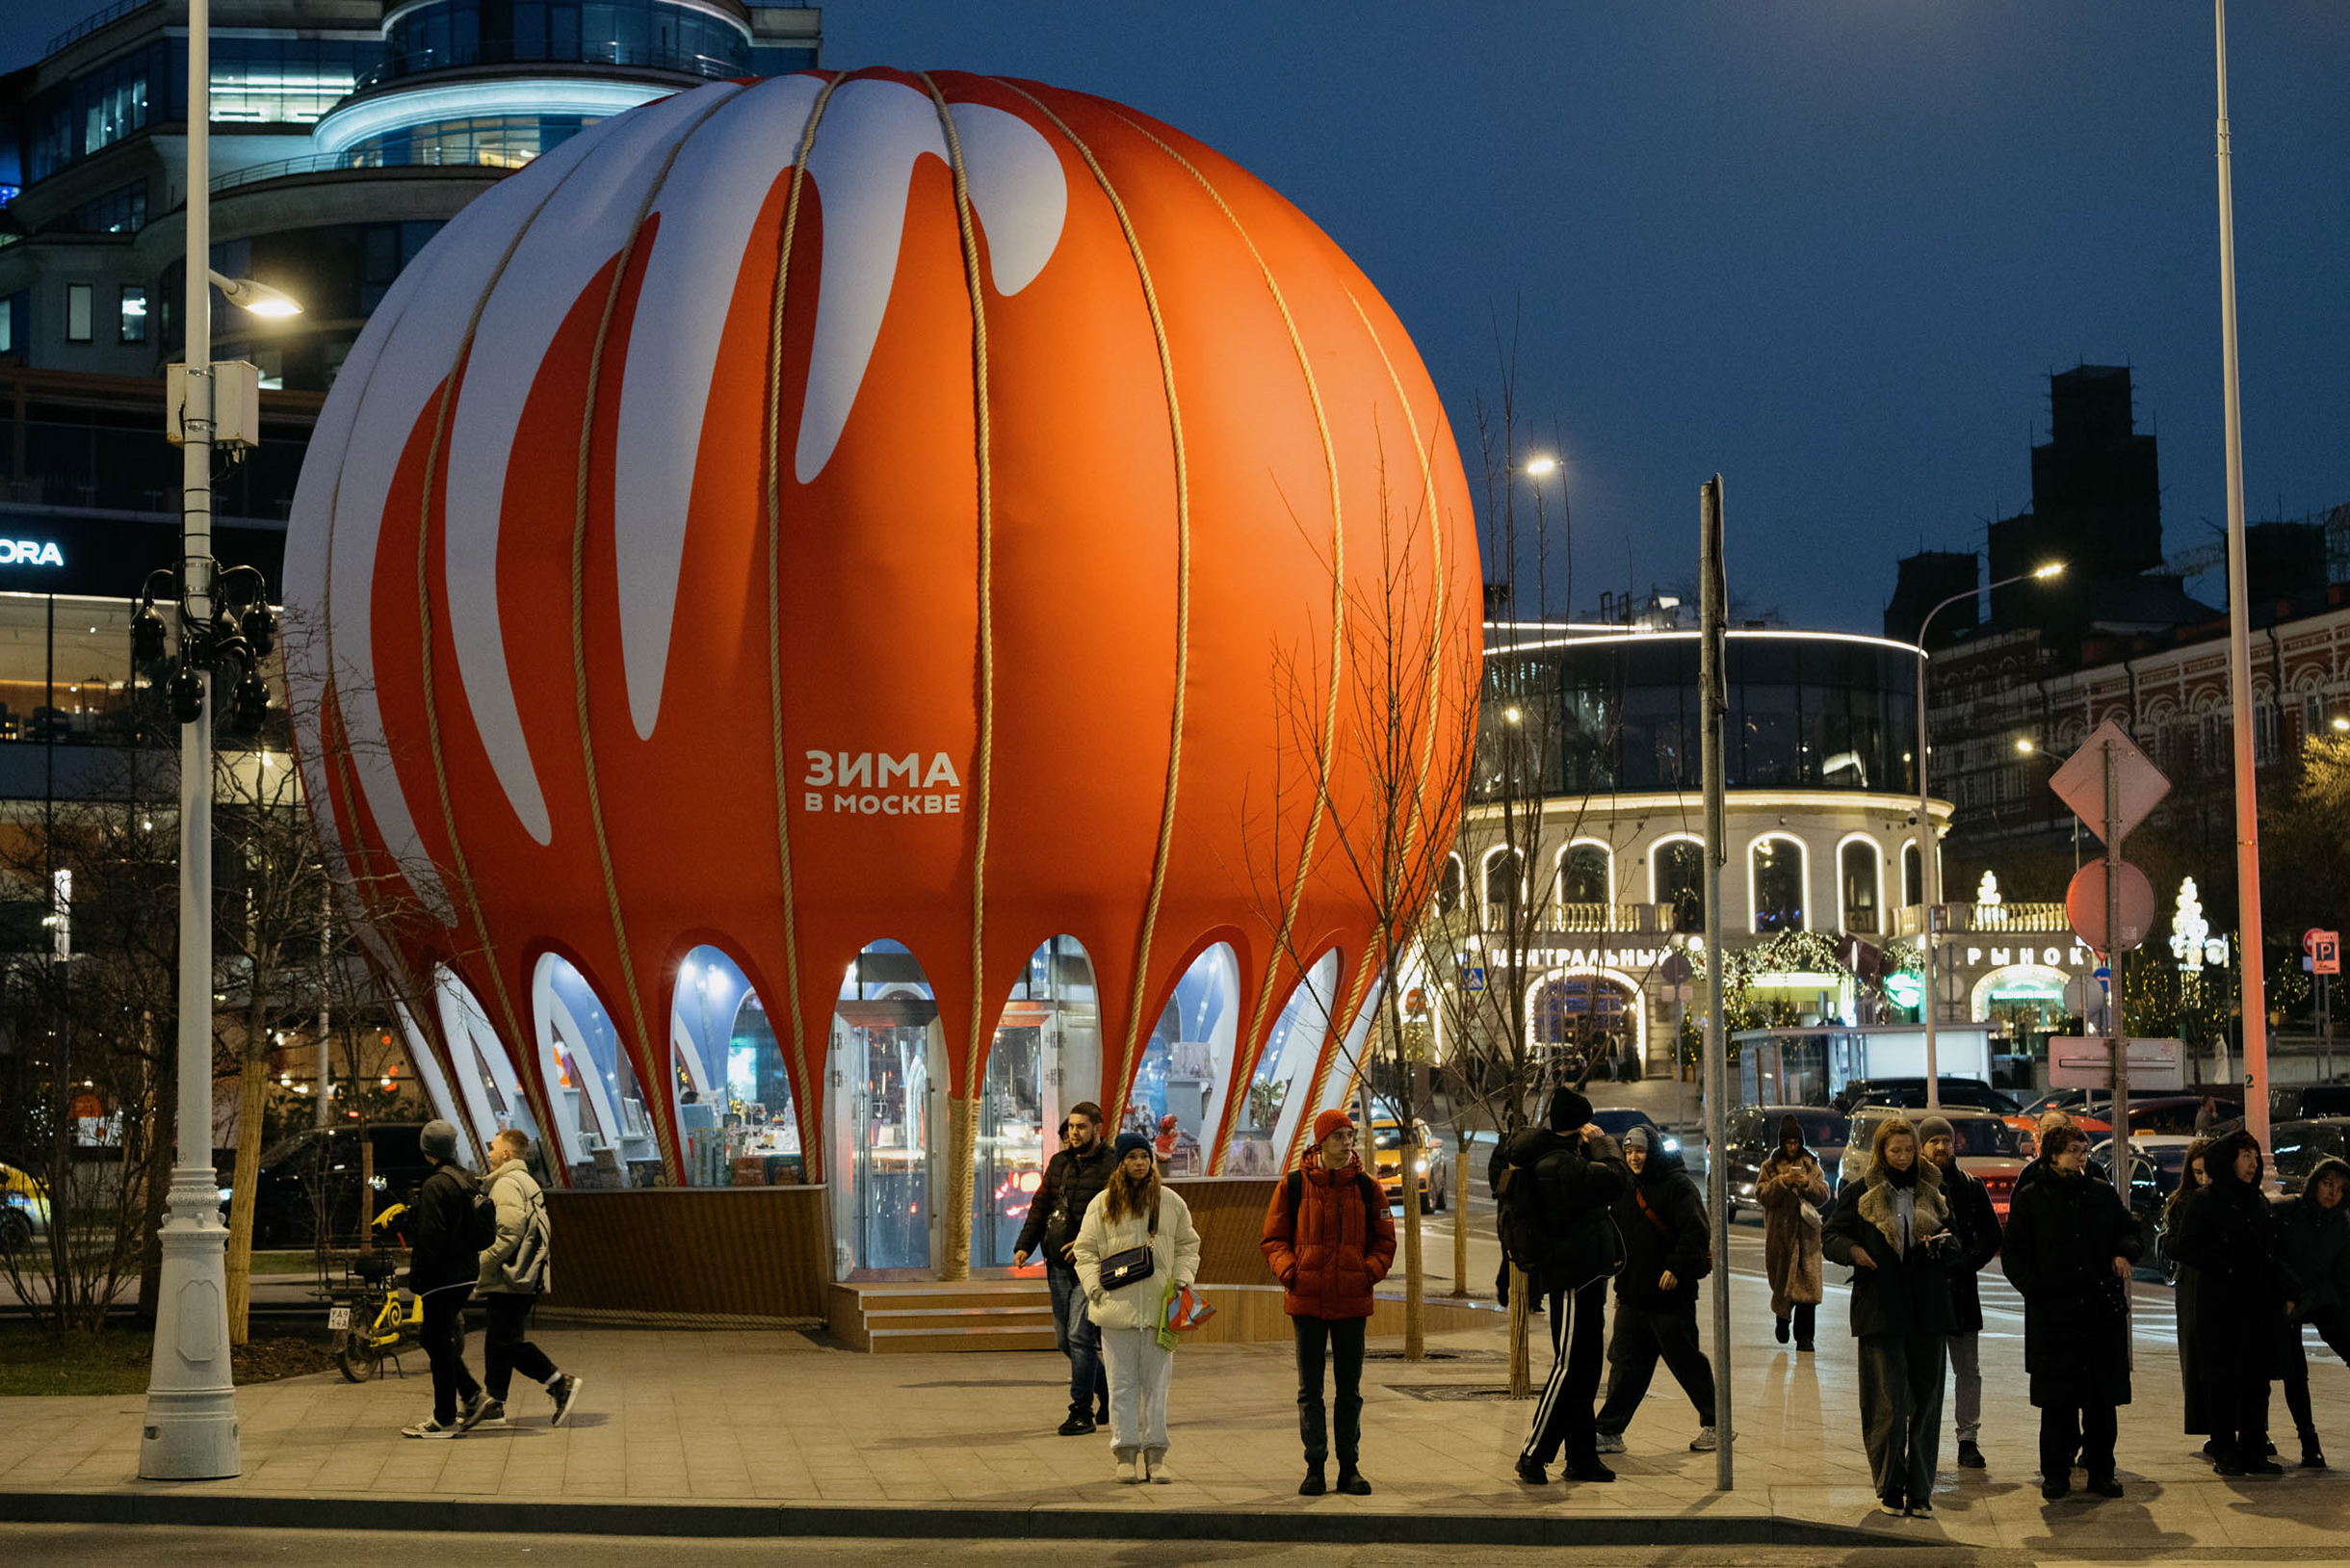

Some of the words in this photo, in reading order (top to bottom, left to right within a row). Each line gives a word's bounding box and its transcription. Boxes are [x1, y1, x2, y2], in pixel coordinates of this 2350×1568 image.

[804, 749, 960, 788] ЗИМА
[805, 792, 823, 812] В
[834, 794, 960, 815] МОСКВЕ
[1967, 947, 2084, 966] РЫНОК
